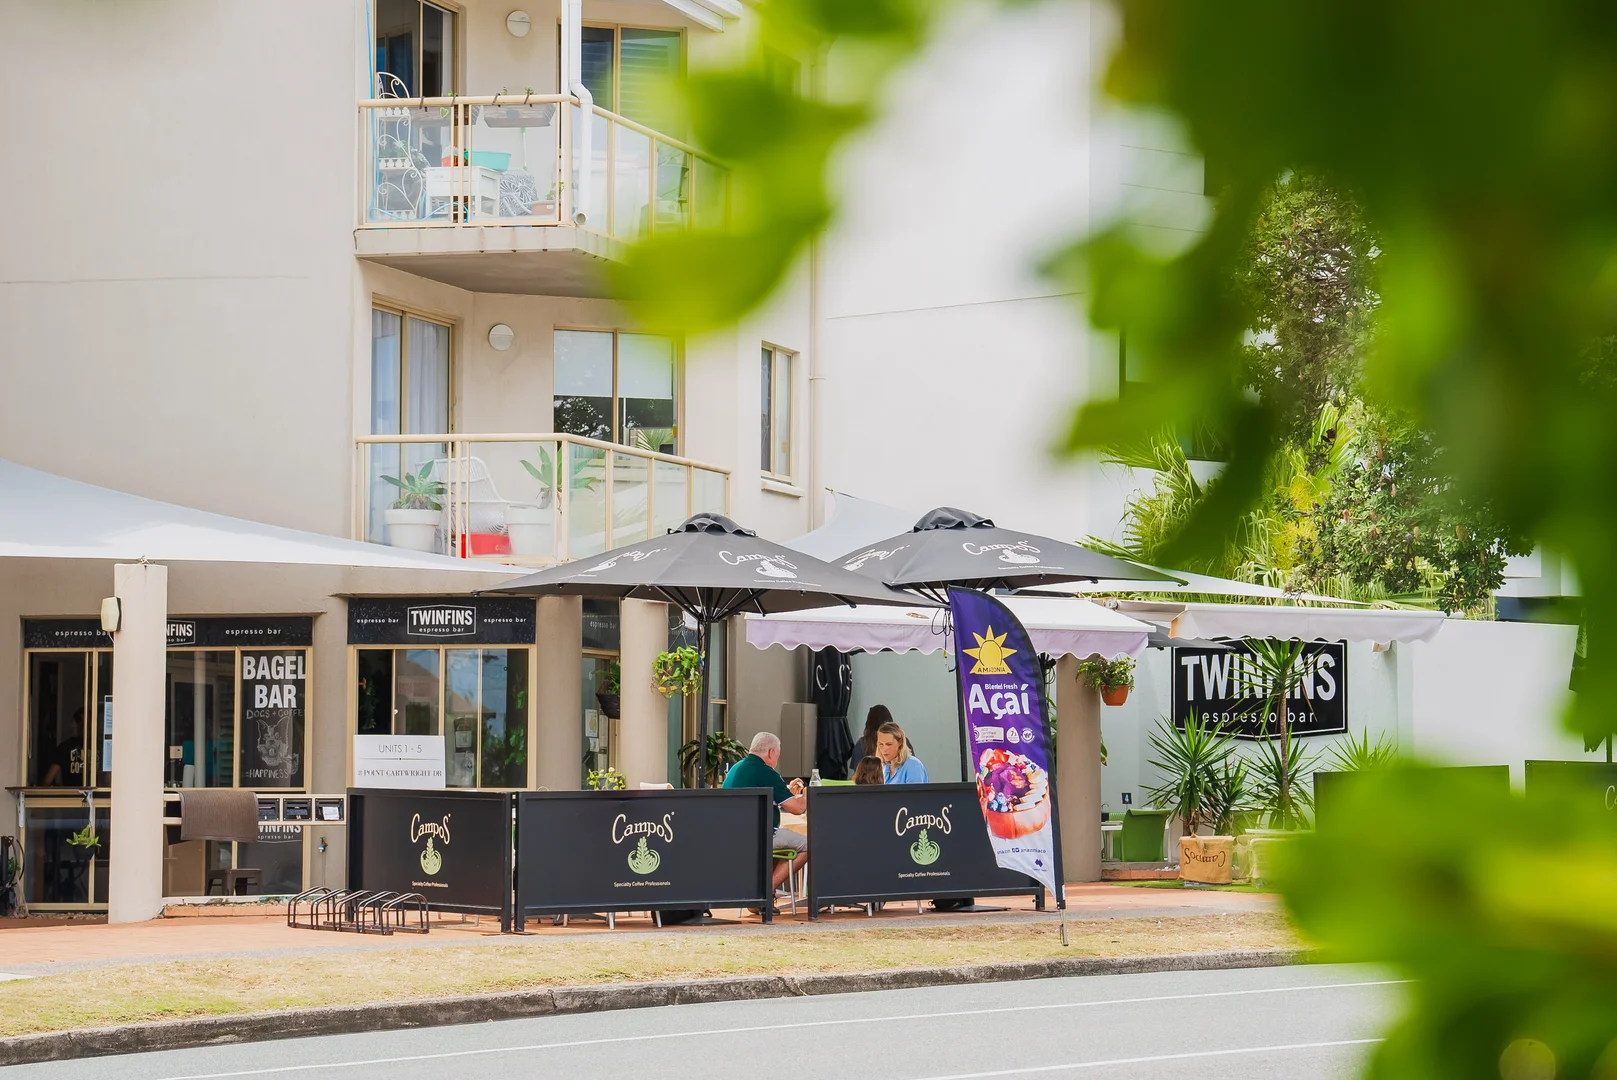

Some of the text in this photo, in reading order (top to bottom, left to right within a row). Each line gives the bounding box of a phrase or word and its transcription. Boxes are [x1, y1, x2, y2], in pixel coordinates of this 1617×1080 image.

[410, 609, 473, 626] TWINFINS
[242, 655, 306, 680] BAGEL
[254, 684, 297, 709] BAR
[968, 683, 1031, 720] Açaí
[278, 708, 303, 718] COFFE
[1287, 707, 1316, 723] bar
[378, 744, 403, 753] UNITS
[404, 744, 408, 753] 1
[416, 744, 423, 754] 5
[363, 769, 385, 777] POINT
[386, 769, 431, 777] CARTWRIGHT
[432, 769, 442, 777] DR
